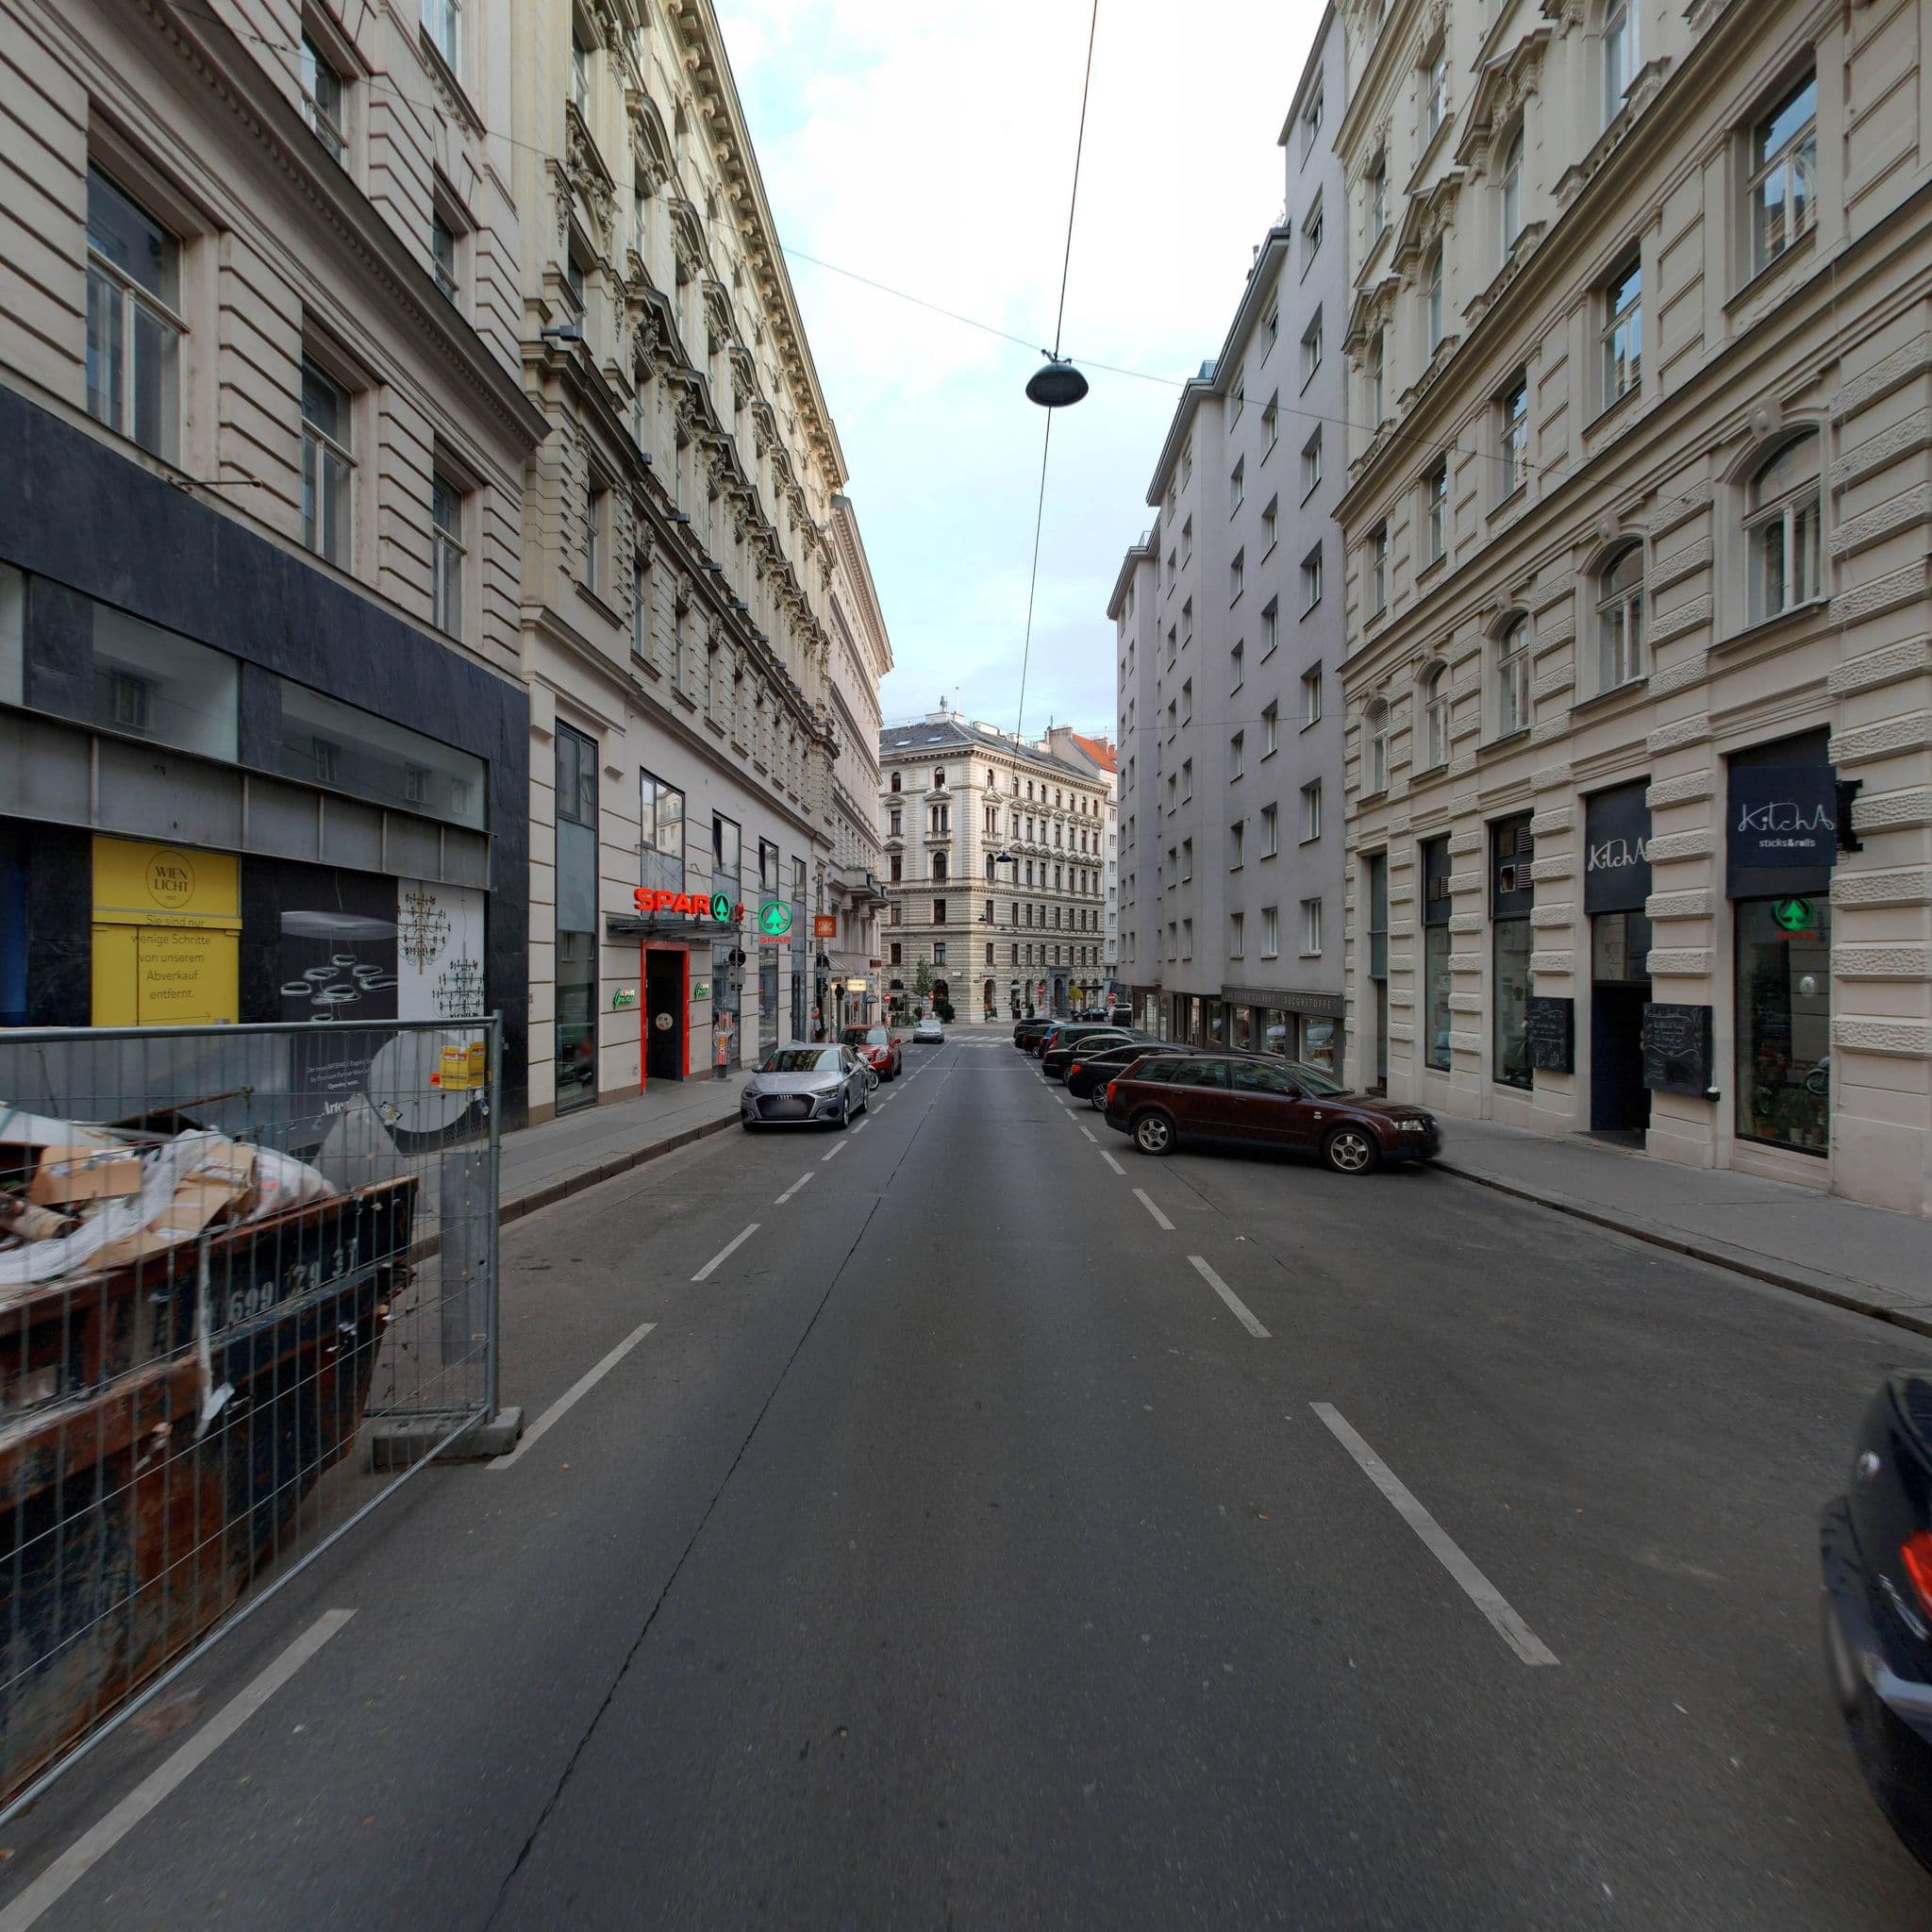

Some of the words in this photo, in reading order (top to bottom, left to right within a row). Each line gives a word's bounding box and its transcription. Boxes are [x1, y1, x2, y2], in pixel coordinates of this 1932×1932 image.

[1758, 838, 1816, 847] sticks&rolls
[155, 866, 188, 880] WIEN
[154, 878, 190, 892] LICHT
[633, 887, 710, 915] SPAR
[146, 914, 161, 925] Sie
[165, 916, 186, 926] sind
[189, 919, 205, 927] nur
[131, 935, 169, 947] wenige
[172, 933, 211, 946] Schritte
[140, 954, 158, 962] von
[160, 953, 205, 962] unserem
[146, 969, 199, 981] Abverkauf
